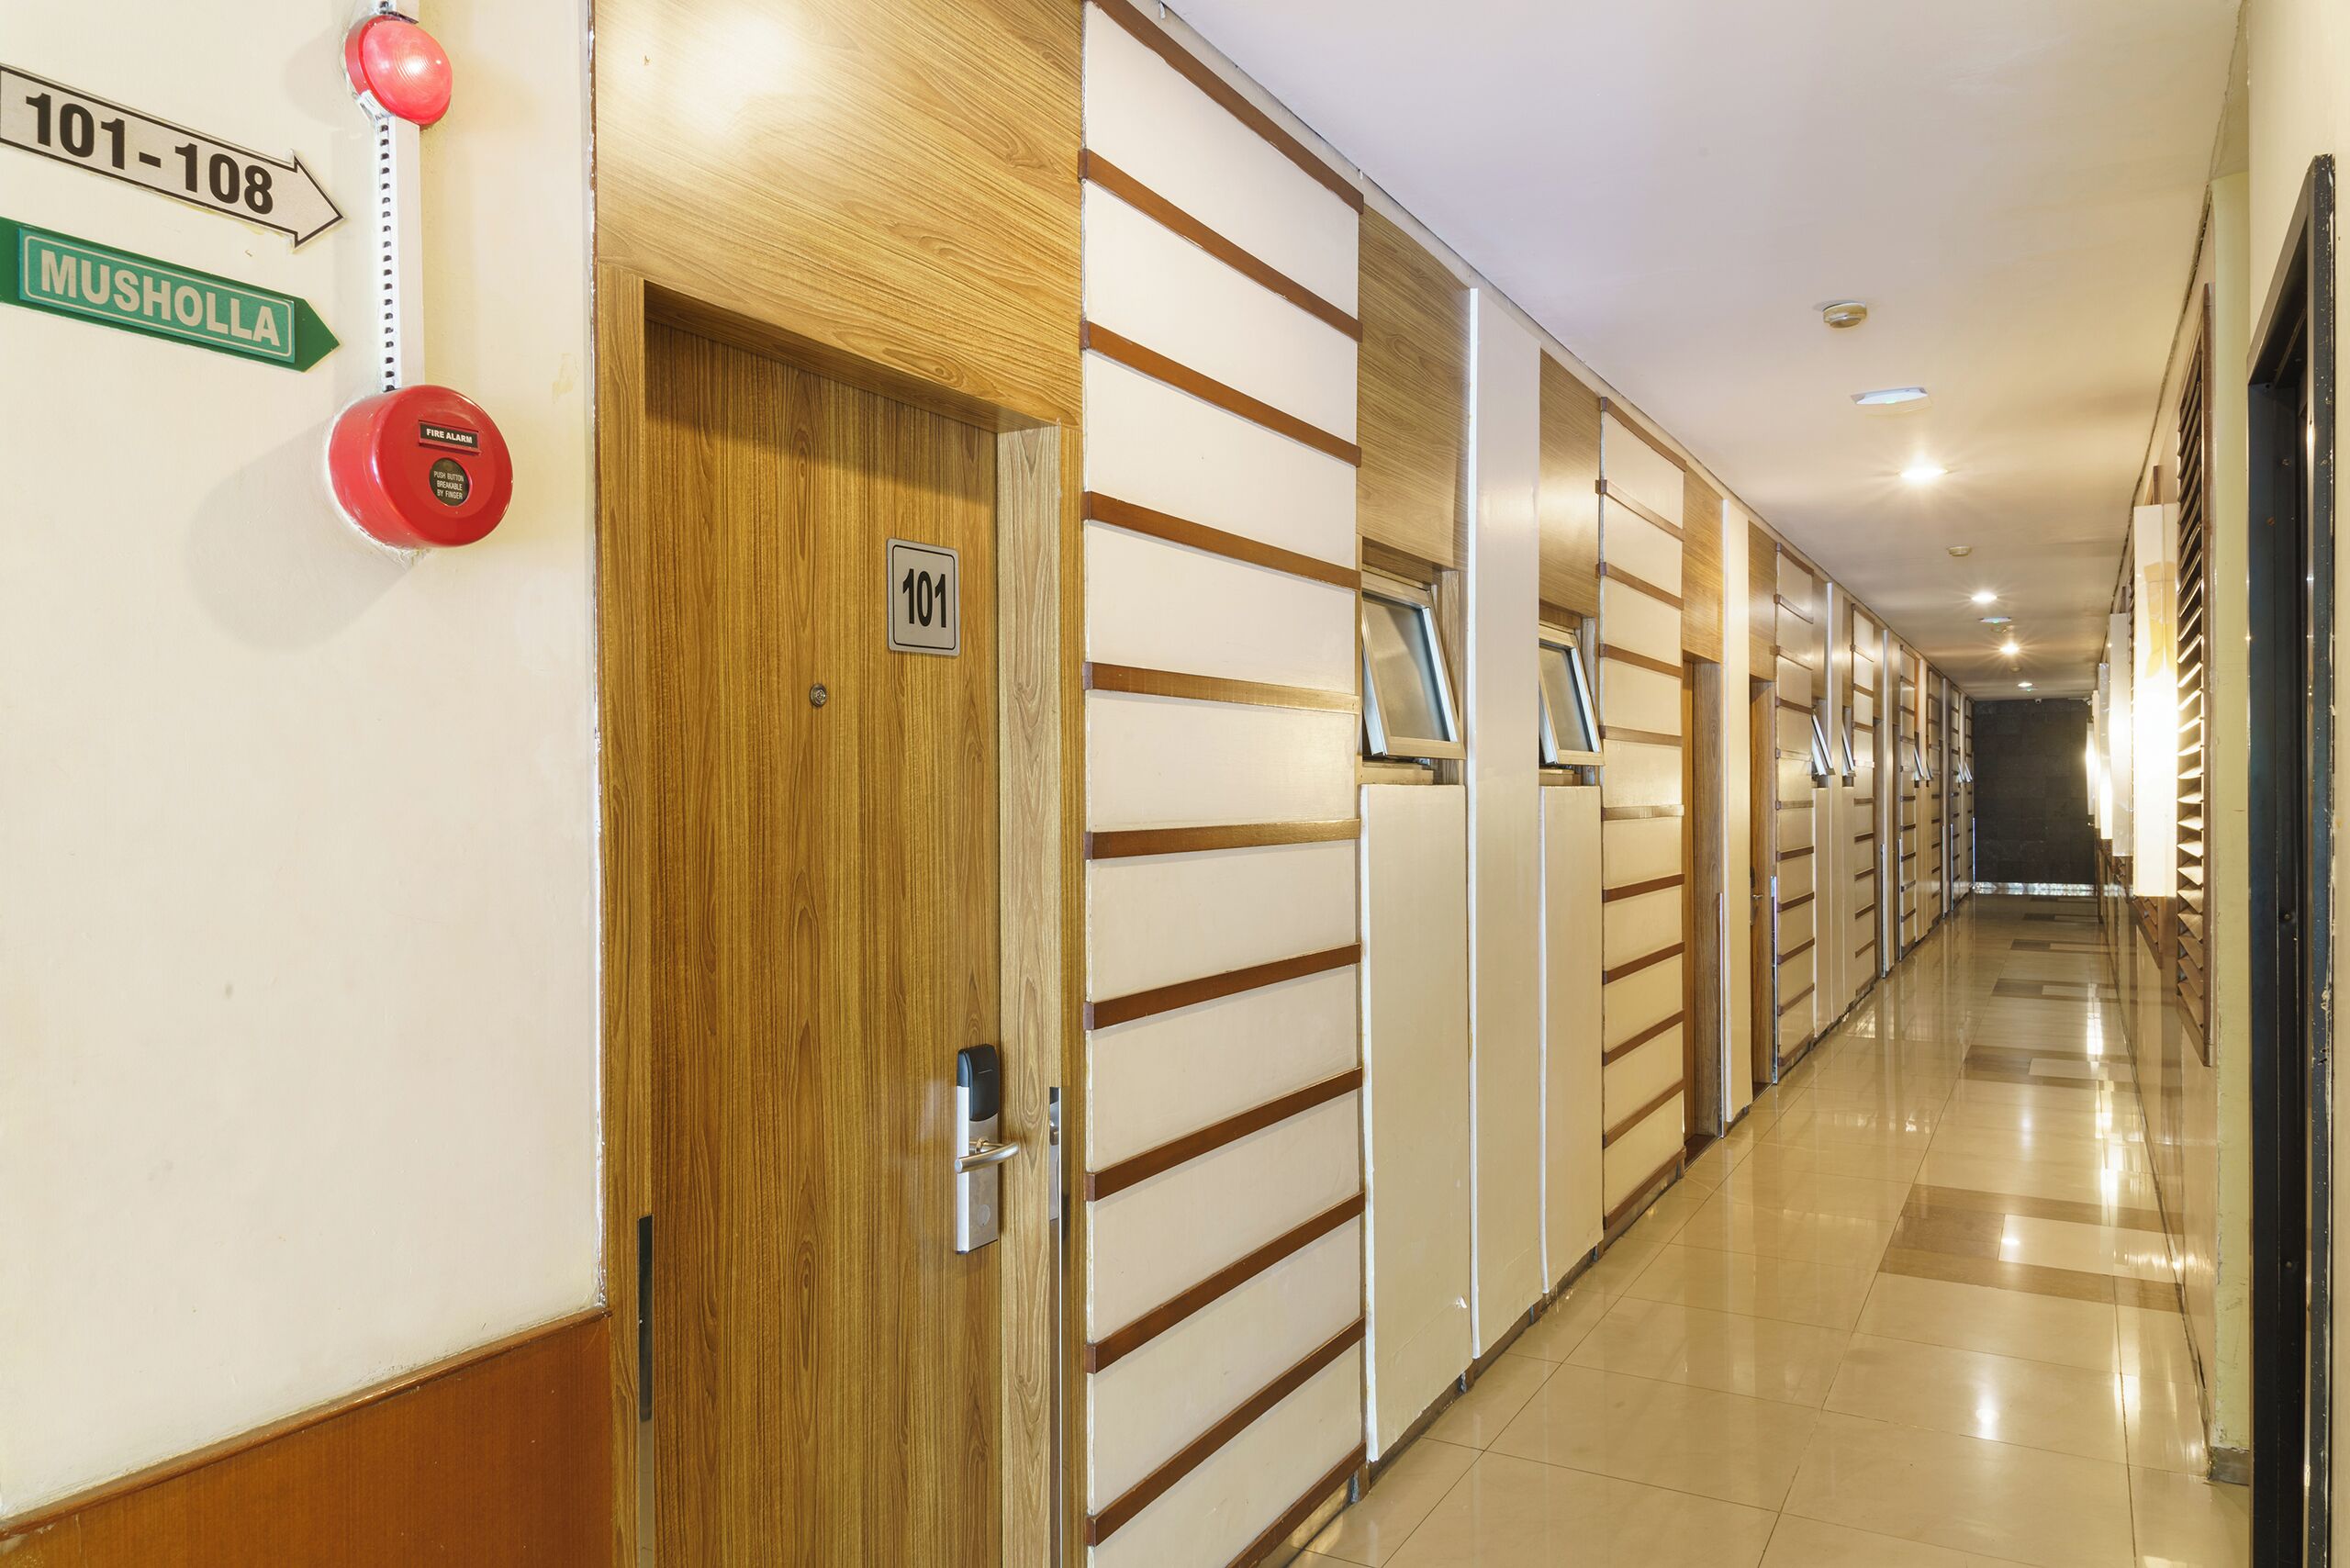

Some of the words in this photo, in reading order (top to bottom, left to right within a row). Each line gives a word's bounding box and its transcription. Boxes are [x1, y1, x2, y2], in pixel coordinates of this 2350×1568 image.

[41, 249, 281, 347] MUSHOLLA
[426, 428, 445, 439] FIRE
[446, 432, 473, 443] ALARM
[447, 473, 464, 482] BUTTON
[436, 480, 463, 491] BREAKABLE
[437, 488, 444, 497] BY
[445, 489, 464, 499] FINGER
[902, 568, 946, 628] 101
